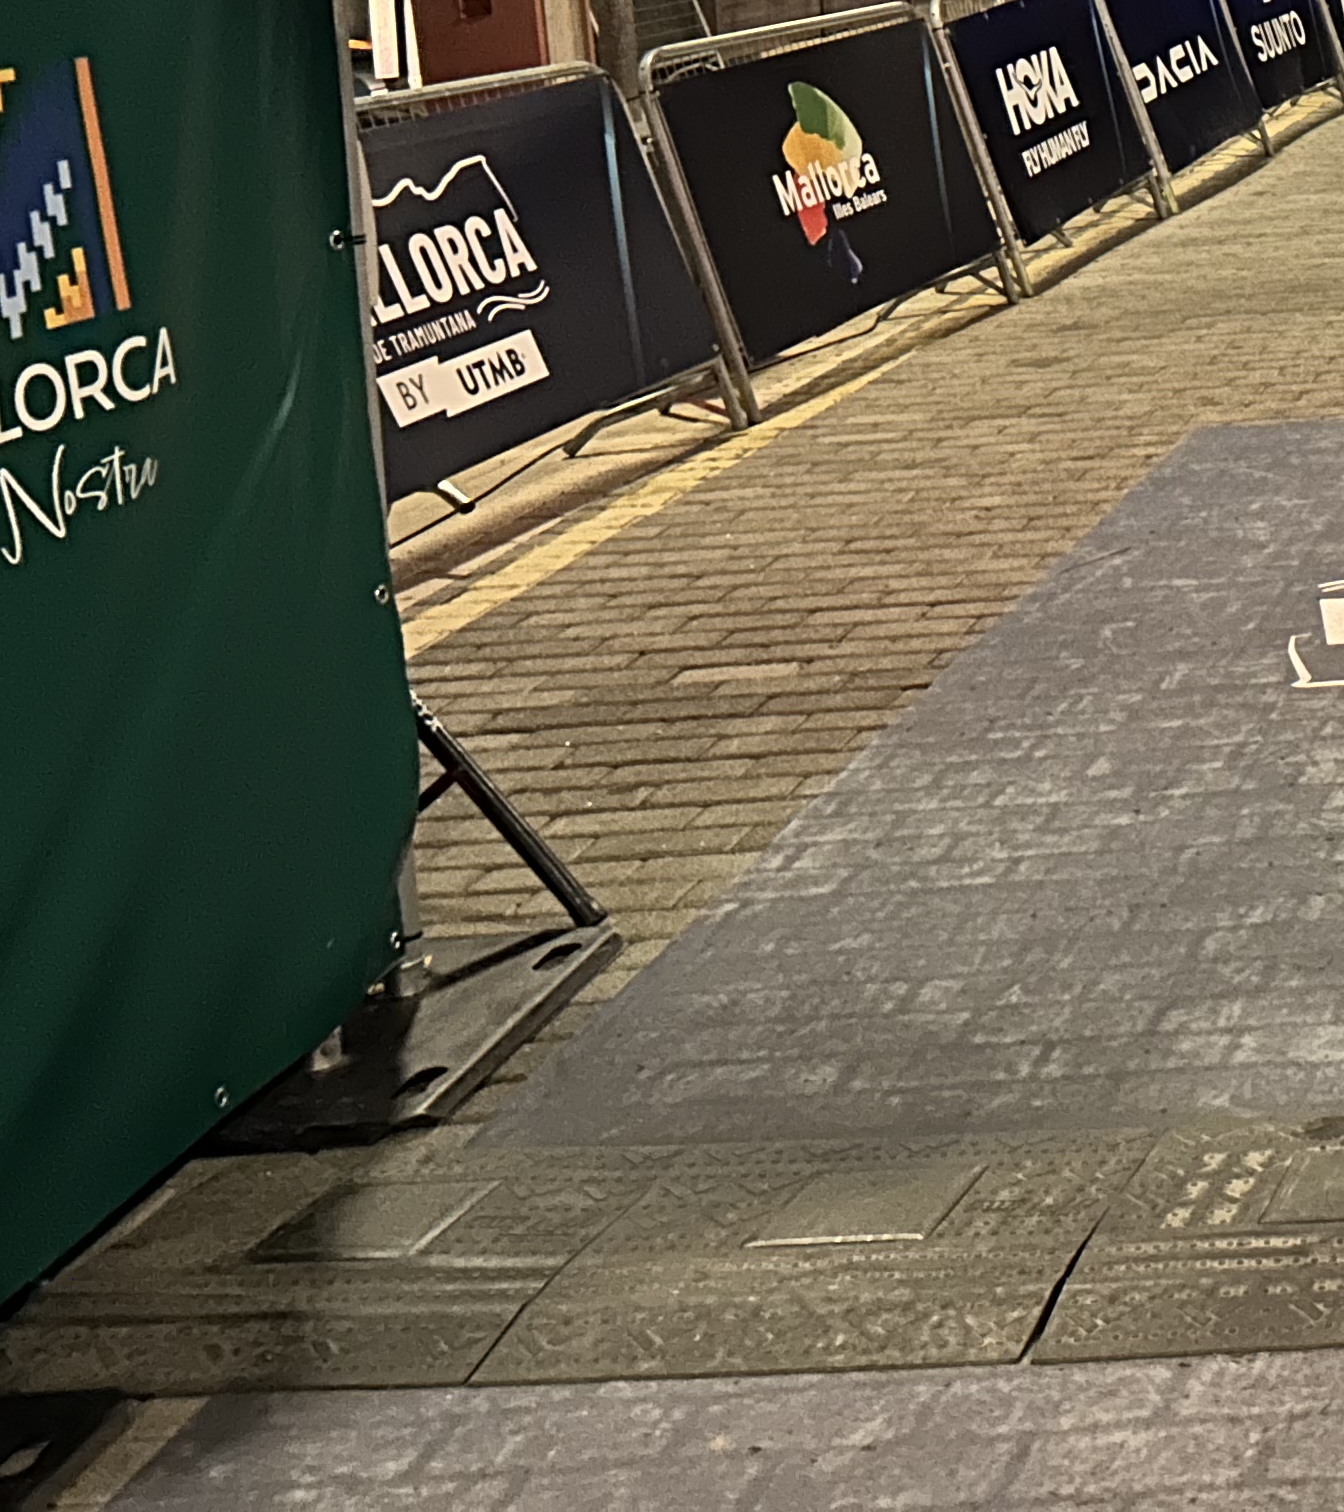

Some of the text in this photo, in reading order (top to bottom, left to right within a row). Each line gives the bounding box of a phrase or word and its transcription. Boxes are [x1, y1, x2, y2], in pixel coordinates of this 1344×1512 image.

[1250, 10, 1306, 62] SUUNTO
[995, 46, 1081, 136] HOKA
[1132, 35, 1219, 104] DACIA
[772, 152, 881, 216] Mallorca
[852, 189, 888, 213] Balears
[388, 309, 477, 356] TRAMUNTANA
[396, 348, 526, 411] BY UTMB
